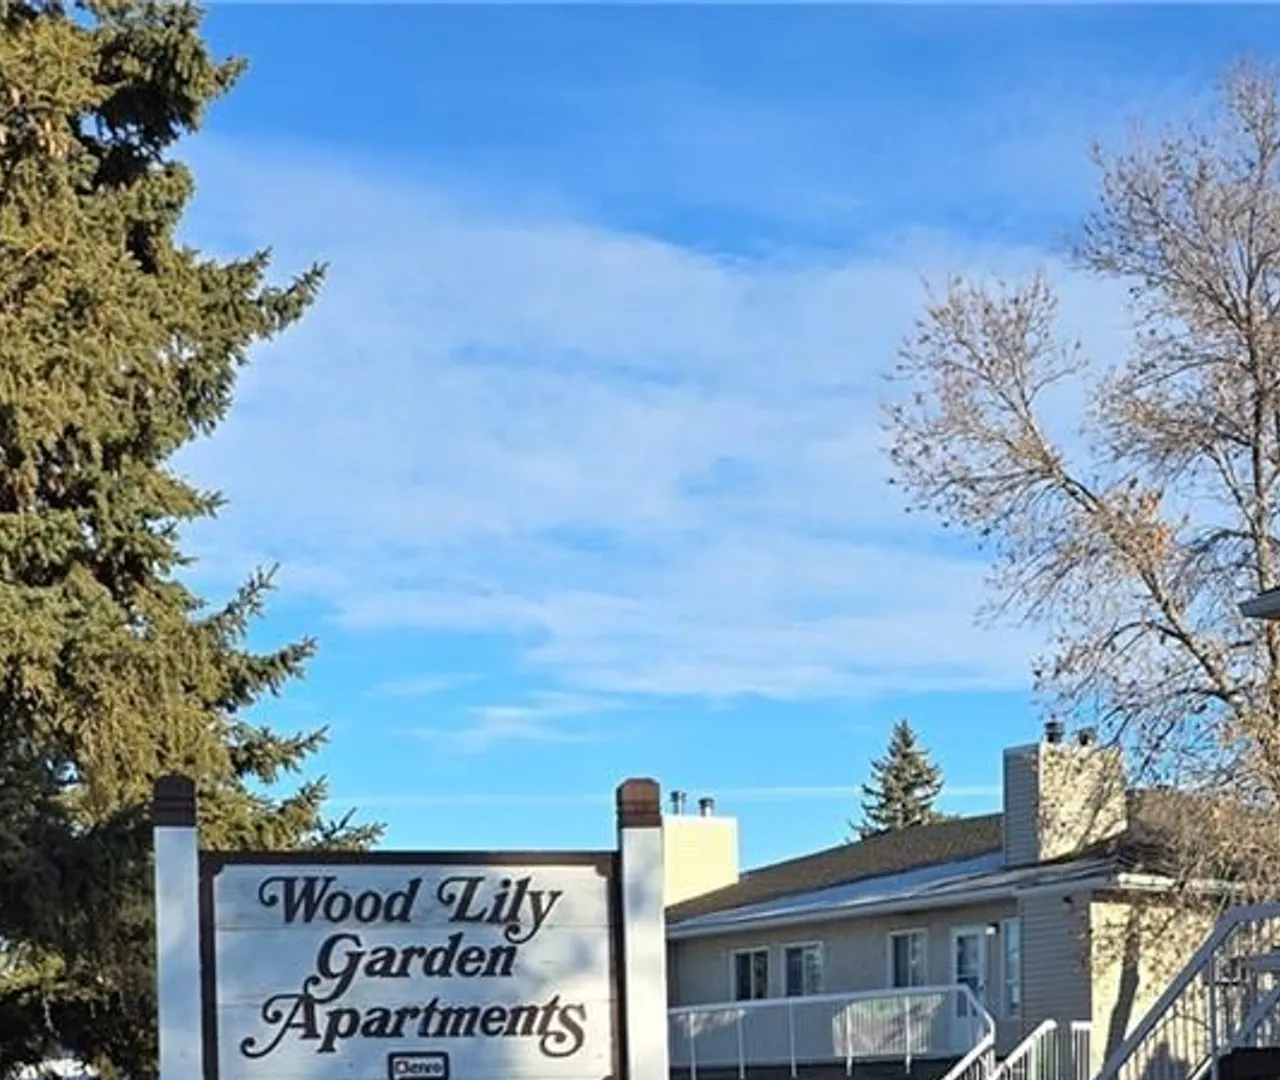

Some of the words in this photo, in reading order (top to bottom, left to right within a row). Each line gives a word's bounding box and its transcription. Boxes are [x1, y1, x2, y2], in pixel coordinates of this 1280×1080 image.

[258, 875, 422, 923] Wood
[437, 875, 563, 944] Lily
[303, 931, 518, 1004] Garden
[239, 994, 587, 1058] Apartments
